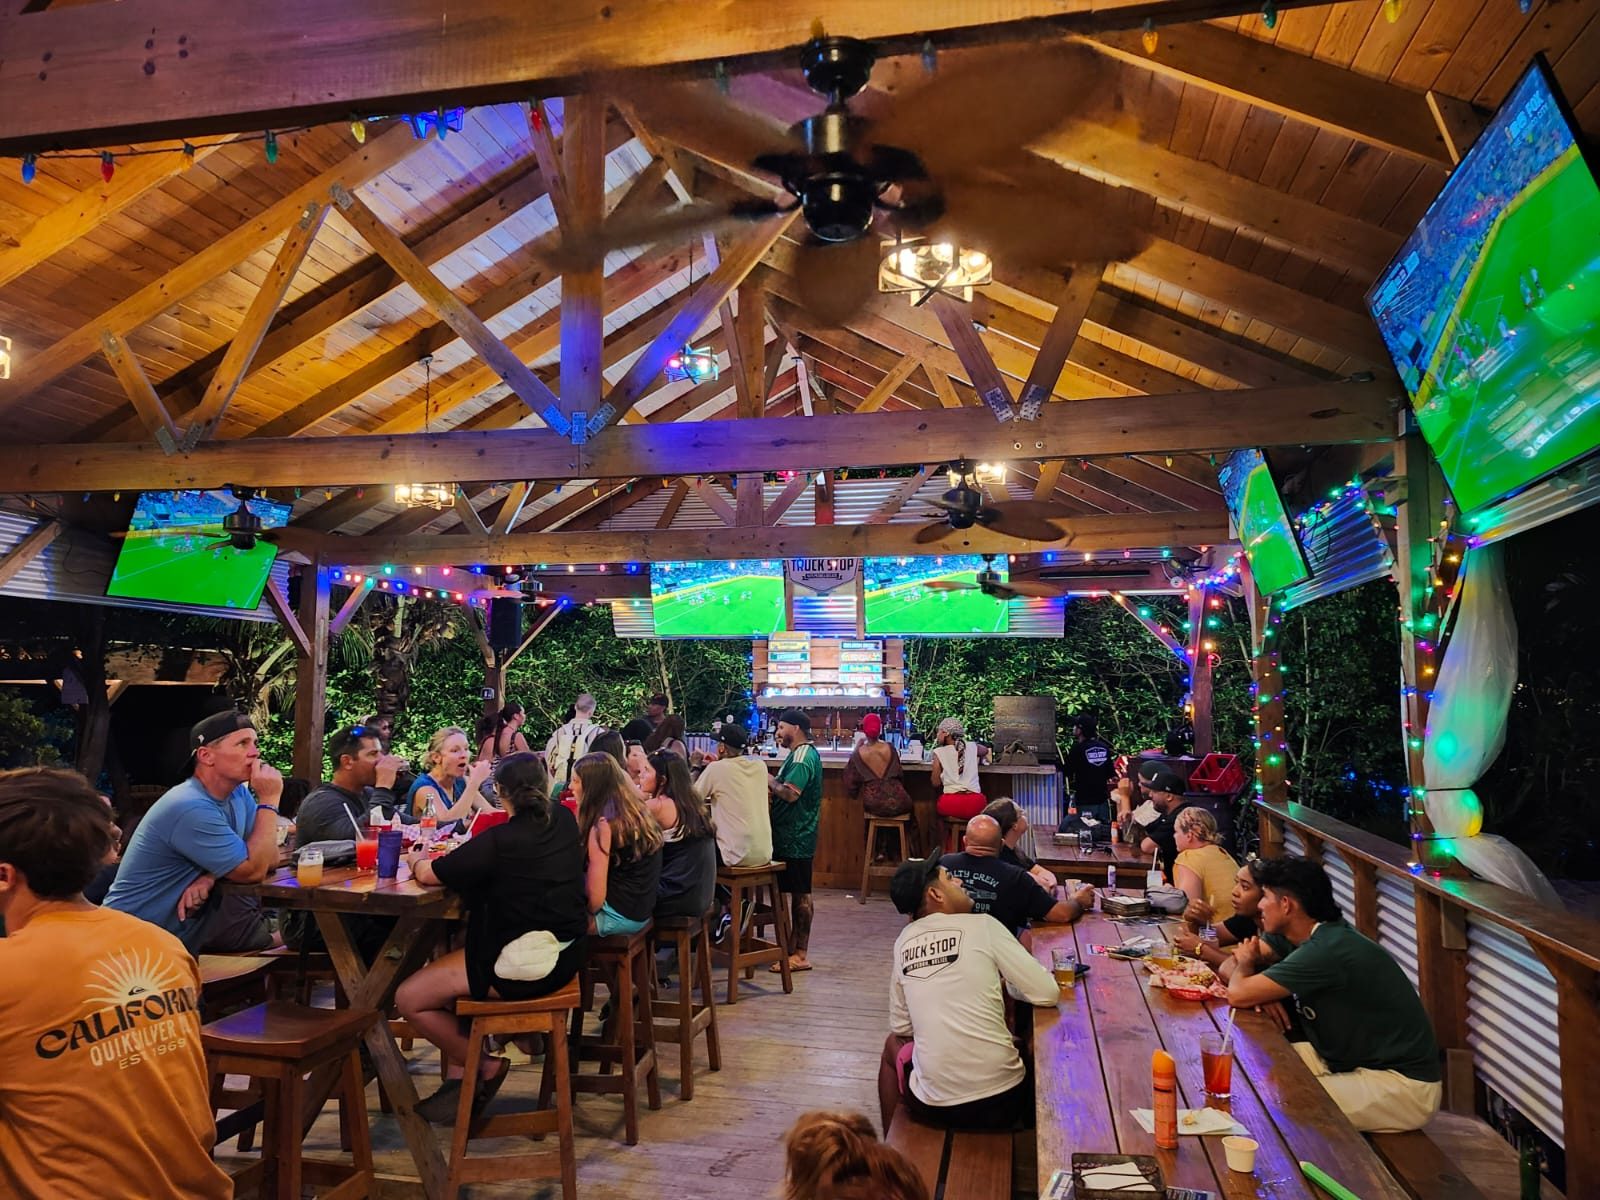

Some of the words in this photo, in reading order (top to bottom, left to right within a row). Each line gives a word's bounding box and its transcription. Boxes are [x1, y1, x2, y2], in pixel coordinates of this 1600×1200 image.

[791, 559, 825, 572] TRUCK
[972, 872, 1000, 888] CREW
[902, 944, 928, 964] TRUCK
[929, 937, 957, 956] STOP
[89, 1020, 177, 1067] QUIKSILVER
